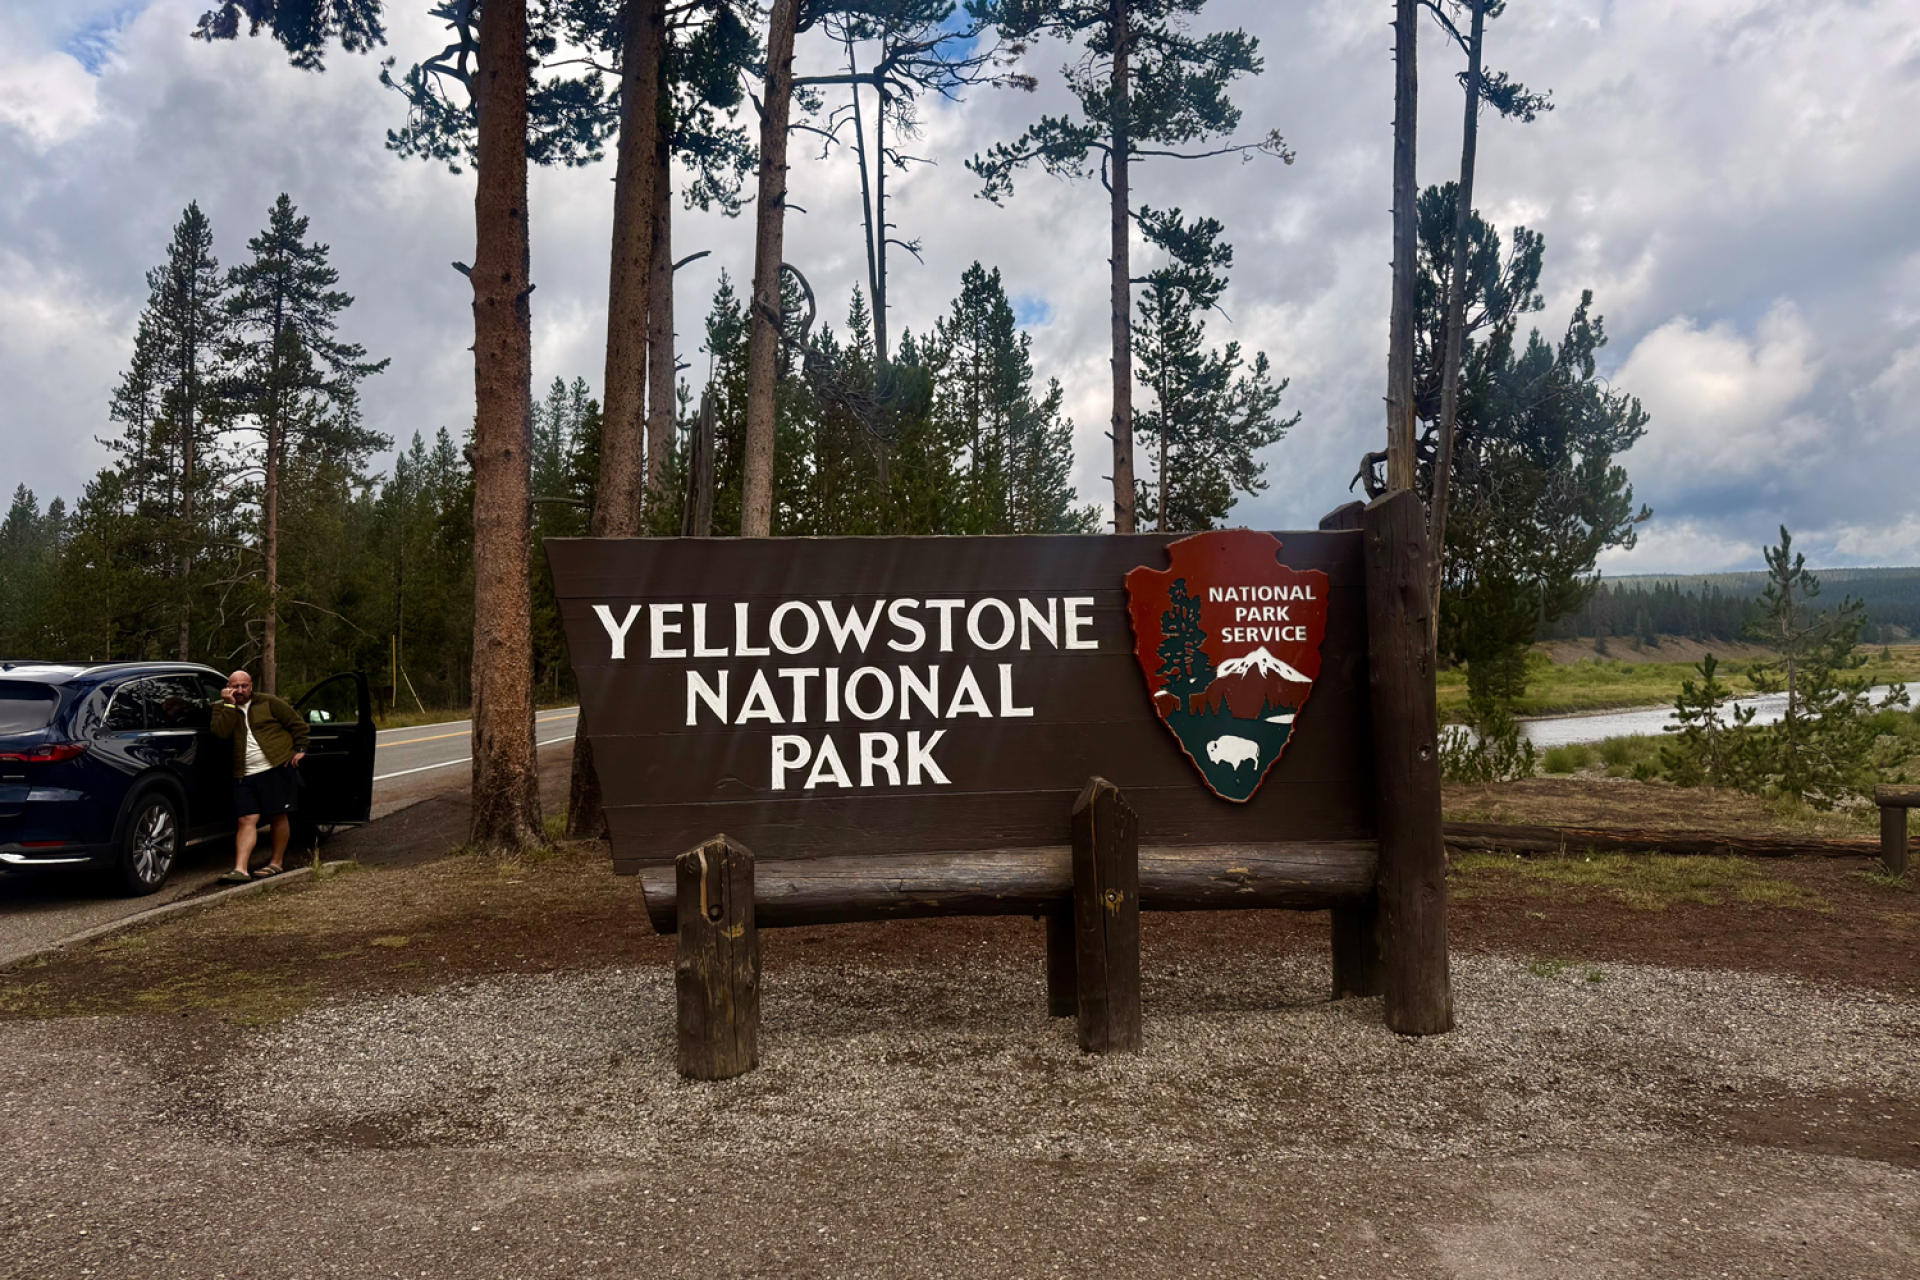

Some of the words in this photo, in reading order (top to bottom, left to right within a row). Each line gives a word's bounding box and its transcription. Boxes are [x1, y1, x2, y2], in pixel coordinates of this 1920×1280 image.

[1208, 585, 1317, 602] NATIONAL
[592, 596, 1100, 660] YELLOWSTONE
[1220, 625, 1308, 643] SERVICE
[1235, 606, 1291, 623] PARK
[685, 663, 1035, 727] NATIONAL
[770, 729, 953, 791] PARK
